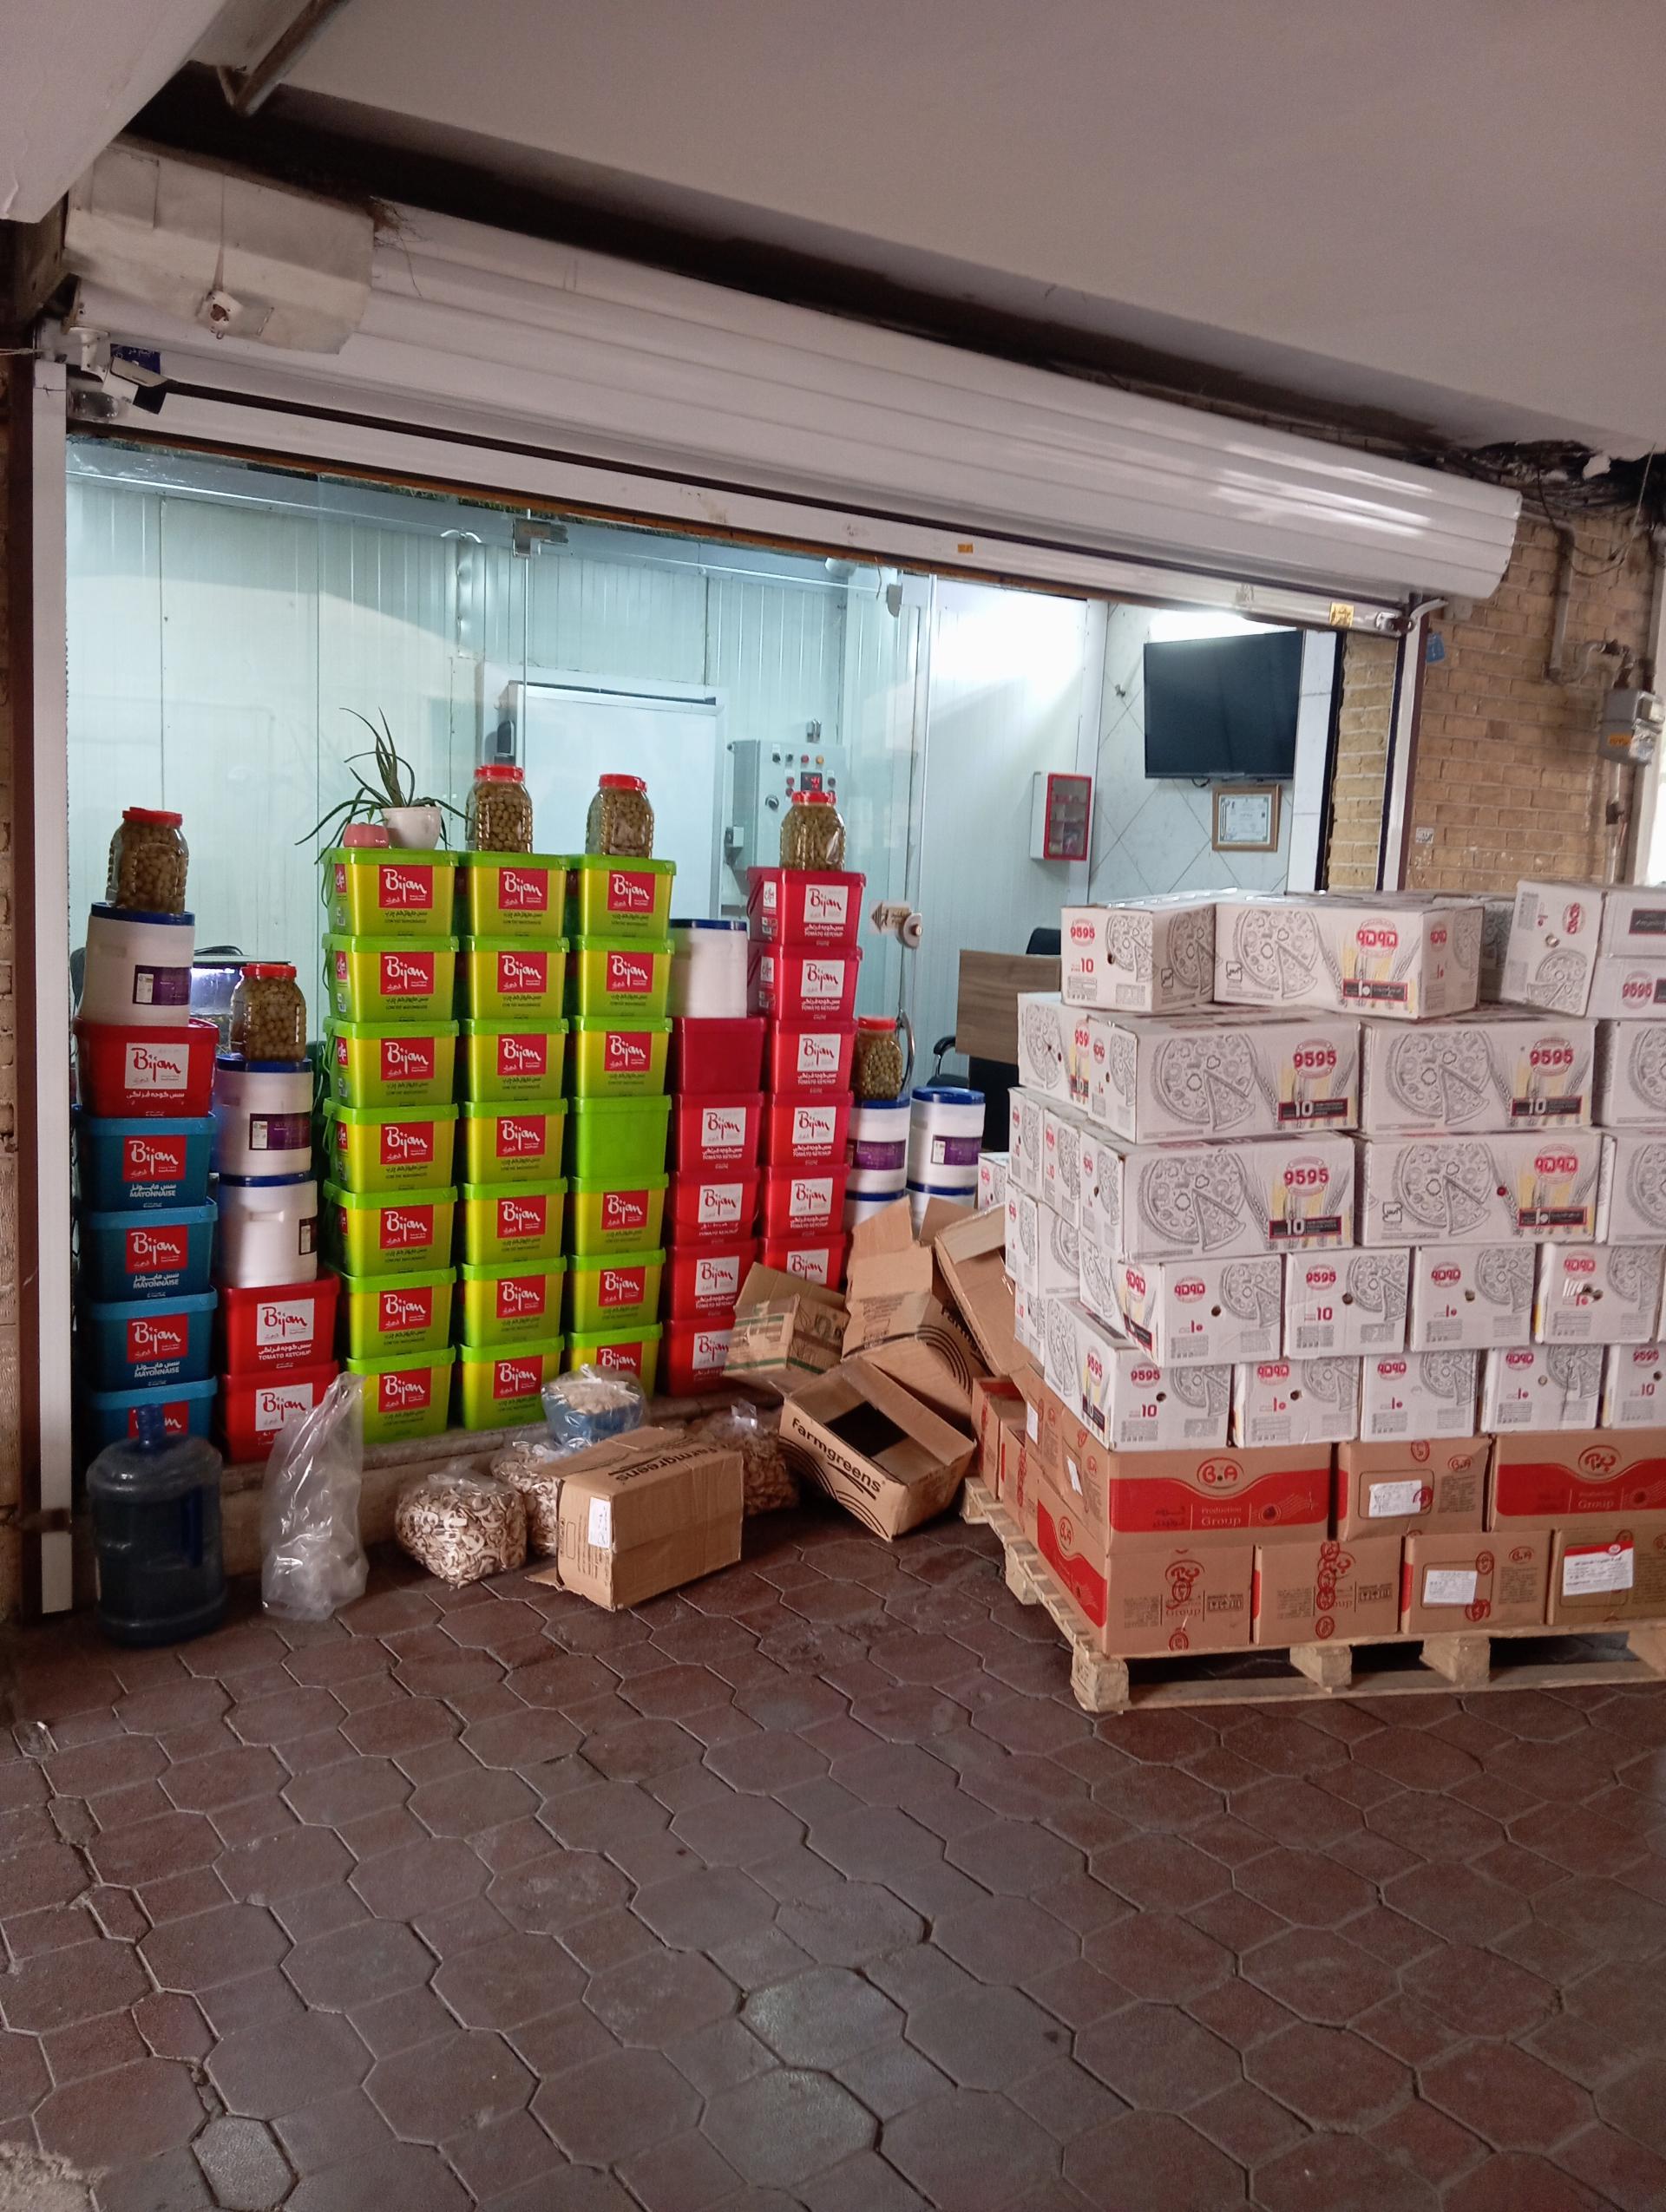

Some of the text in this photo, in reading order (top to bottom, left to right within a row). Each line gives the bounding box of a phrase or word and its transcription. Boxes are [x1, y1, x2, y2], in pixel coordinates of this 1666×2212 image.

[383, 868, 427, 903] Bijan
[503, 871, 542, 905] Bijan
[612, 874, 650, 906] Bijan
[810, 887, 842, 917] Bijan
[1070, 926, 1095, 940] 9595
[384, 956, 429, 989] Bijan
[502, 955, 541, 987] Bijan
[610, 955, 648, 987] Bijan
[806, 963, 838, 992] Bijan
[1081, 958, 1094, 972] 10
[609, 1035, 646, 1066] Bijan
[803, 1037, 835, 1066] Bijan
[1074, 1030, 1090, 1047] 959
[131, 1047, 180, 1083] Bijan
[385, 1042, 429, 1075] Bijan
[502, 1038, 541, 1070] Bijan
[1293, 1050, 1337, 1068] 9595
[1530, 1048, 1573, 1066] 9595
[1294, 1101, 1314, 1117] 10
[1528, 1098, 1546, 1115] 10
[501, 1120, 541, 1150] Bijan
[706, 1112, 740, 1141] Bijan
[798, 1110, 830, 1139] Bijan
[385, 1127, 428, 1158] Bijan
[128, 1140, 179, 1175] Bijan
[1284, 1168, 1329, 1186] 9595
[607, 1194, 642, 1224] Bijan
[703, 1188, 736, 1216] Bijan
[795, 1183, 827, 1210] Bijan
[384, 1210, 427, 1242] Bijan
[501, 1201, 541, 1232] Bijan
[1286, 1219, 1305, 1235] 10
[130, 1232, 180, 1265] Bijan
[700, 1262, 733, 1289] Bijan
[791, 1254, 823, 1279] Bijan
[1306, 1271, 1336, 1283] 9595
[133, 1279, 179, 1289] MAYONNAISE
[501, 1281, 540, 1311] Bijan
[604, 1271, 640, 1300] Bijan
[262, 1306, 307, 1337] Bijan
[384, 1294, 426, 1325] Bijan
[1317, 1306, 1333, 1320] 10
[132, 1321, 181, 1354] Bijan
[600, 1348, 637, 1370] Bijan
[1087, 1352, 1103, 1380] 9595
[1633, 1350, 1659, 1362] 9595
[134, 1366, 180, 1378] MAYONNAISE
[498, 1363, 536, 1391] Bijan
[1131, 1370, 1160, 1381] 9595
[384, 1375, 425, 1404] Bijan
[1641, 1384, 1655, 1396] 10
[261, 1392, 305, 1422] Bijan
[1141, 1404, 1157, 1417] 10
[791, 1417, 882, 1493] Farmgreens
[1577, 1499, 1614, 1509] Group
[1202, 1517, 1242, 1527] Group
